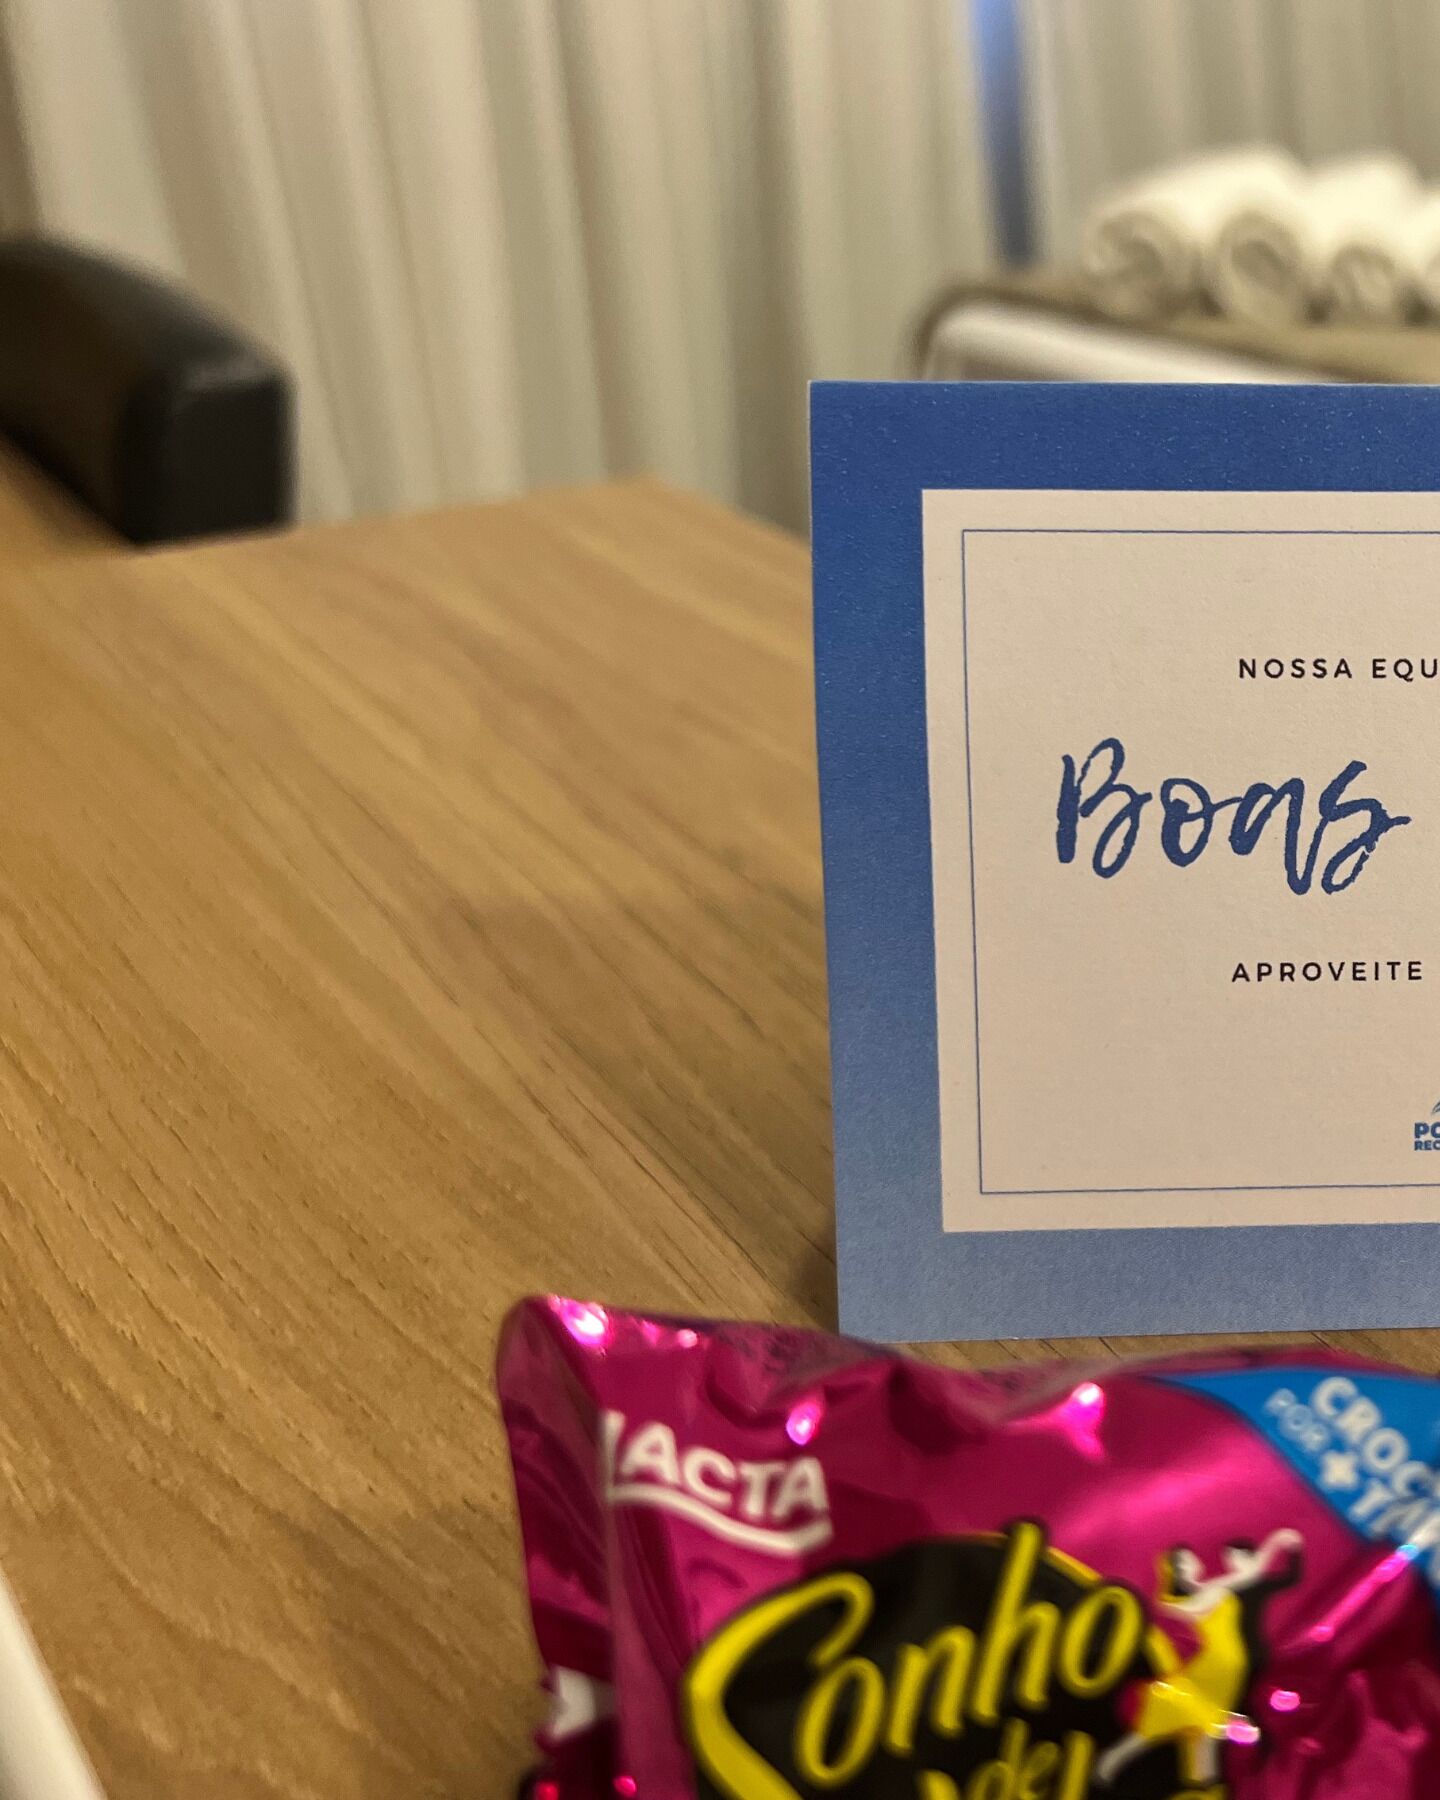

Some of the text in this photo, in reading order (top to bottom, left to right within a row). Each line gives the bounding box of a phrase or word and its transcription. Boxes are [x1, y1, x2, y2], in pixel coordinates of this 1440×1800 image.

[1238, 657, 1353, 680] NOSSA
[1056, 736, 1413, 896] Boas
[1231, 960, 1423, 983] APROVEITE
[682, 1519, 1143, 1800] Sonho
[965, 1717, 1062, 1800] de
